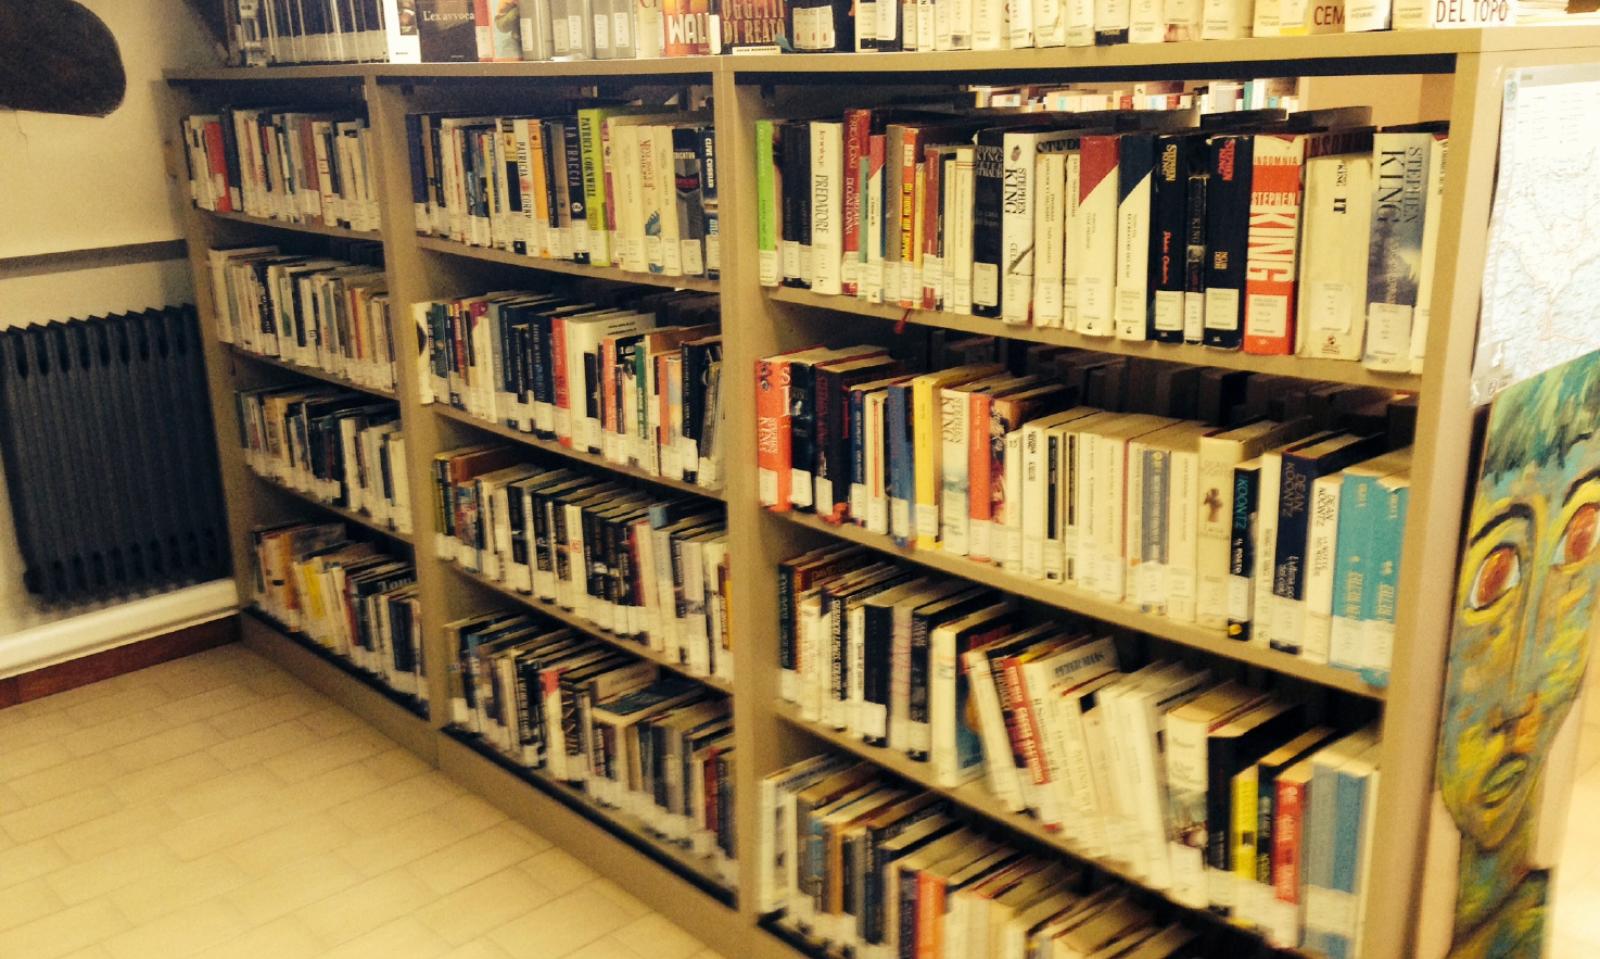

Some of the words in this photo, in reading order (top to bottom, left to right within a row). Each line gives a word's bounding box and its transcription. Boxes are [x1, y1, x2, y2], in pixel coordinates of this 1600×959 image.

[1436, 0, 1466, 22] DEL
[1473, 0, 1508, 21] TOPO
[723, 20, 740, 44] DI
[744, 18, 786, 43] REATO
[565, 126, 577, 138] LA
[581, 117, 593, 154] PATRICIA
[848, 113, 861, 140] ERICA
[517, 141, 529, 177] PATRICIA
[705, 137, 713, 156] CLIVE
[848, 140, 861, 169] JONG
[1161, 152, 1169, 176] KING
[1165, 144, 1177, 182] STEPHEN
[1217, 147, 1226, 174] KING
[1222, 139, 1236, 182] STEPHEN
[1255, 156, 1298, 166] INSOMNIA
[567, 144, 580, 187] TRACCIA
[584, 156, 597, 198] CORNWELL
[706, 157, 715, 189] CUSSLER
[1335, 164, 1345, 187] KING
[1004, 168, 1018, 214] KING
[1017, 167, 1027, 215] STEPHEN
[1251, 192, 1297, 206] STEPHEN
[1376, 151, 1406, 223] KING
[1403, 146, 1423, 223] STEPHEN
[814, 174, 829, 233] PREDATORE
[1333, 197, 1347, 214] IT
[1246, 205, 1297, 282] KING
[760, 417, 771, 452] KING
[770, 417, 778, 454] STEPHEN
[941, 397, 954, 443] KING
[1235, 475, 1248, 529] KOONTZ
[1282, 462, 1296, 518] KOONTZ
[1293, 472, 1306, 512] DEAN
[1315, 487, 1327, 527] KOONTZ
[1325, 493, 1336, 521] DEAN
[1235, 548, 1243, 574] POSTO
